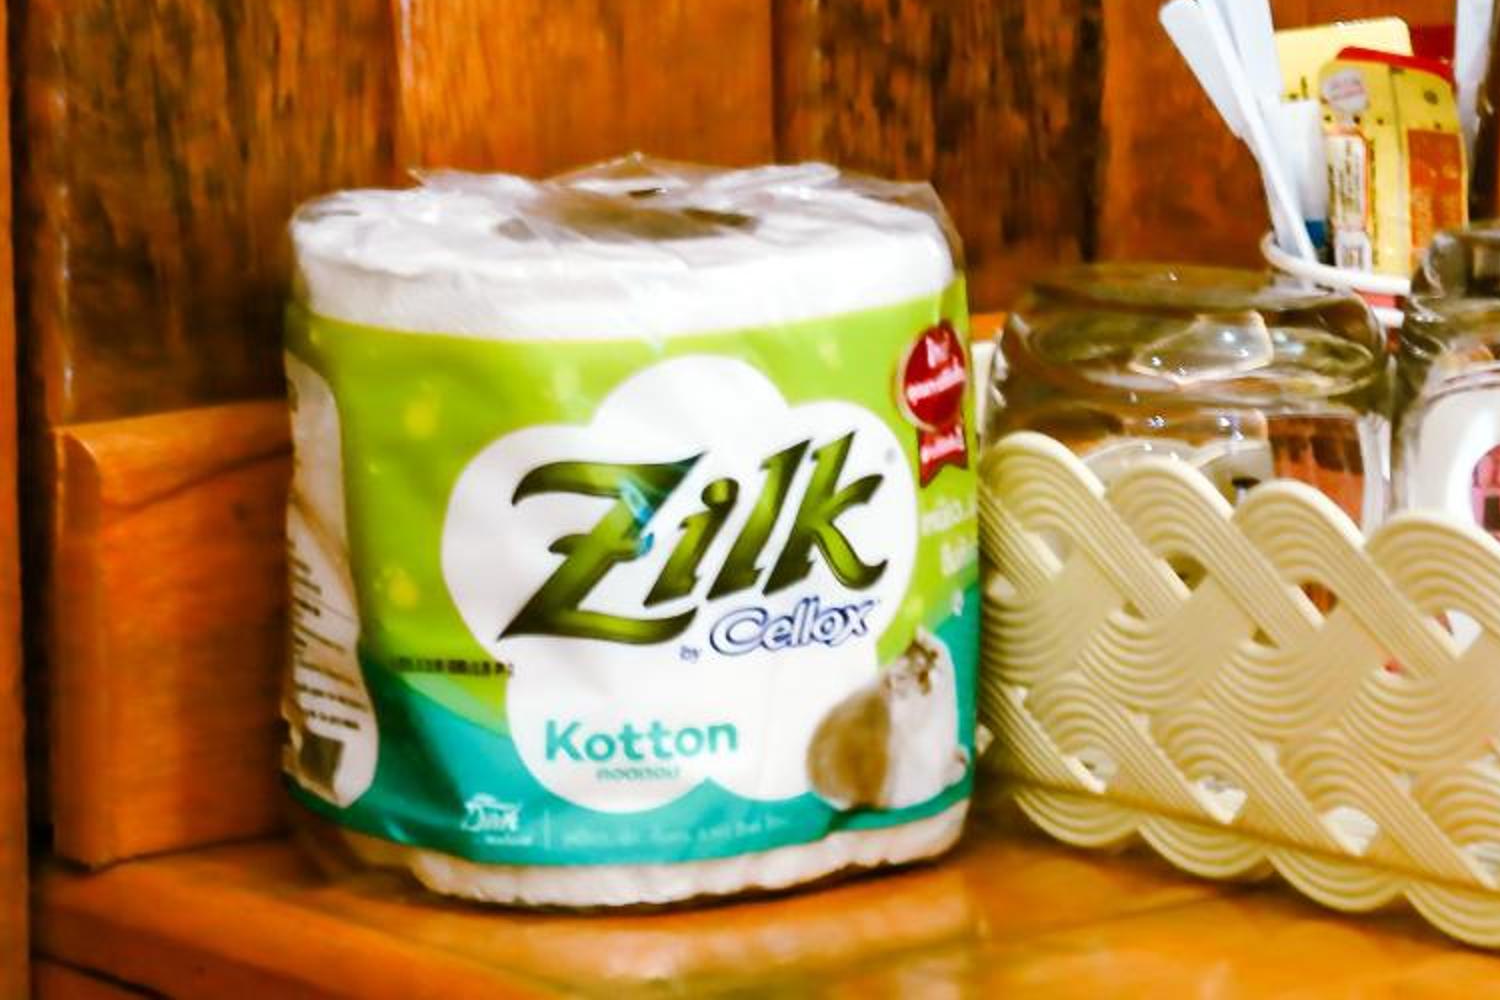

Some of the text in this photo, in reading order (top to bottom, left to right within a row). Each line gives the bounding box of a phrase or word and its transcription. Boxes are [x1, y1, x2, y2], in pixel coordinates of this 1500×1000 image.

[497, 430, 889, 645] Zilk
[709, 597, 873, 657] Cellox
[545, 718, 738, 763] Kotton
